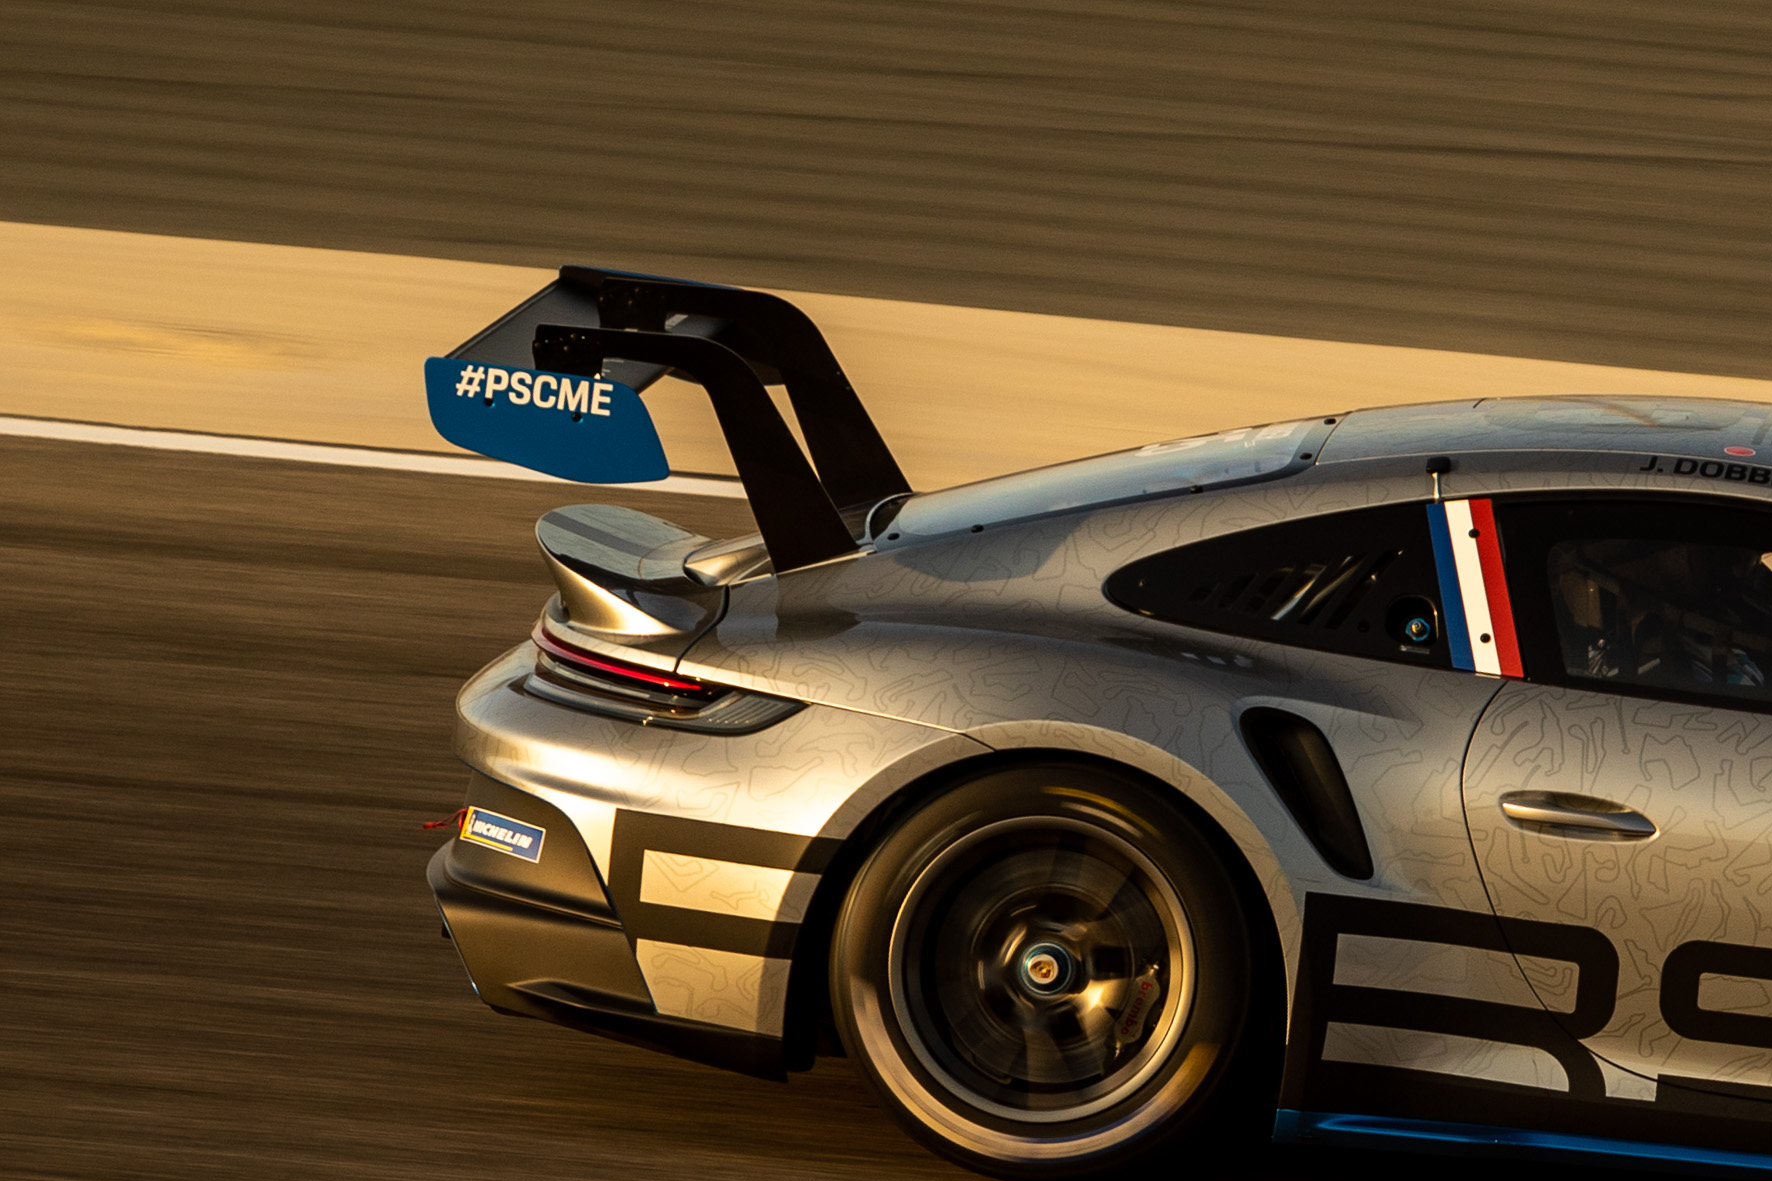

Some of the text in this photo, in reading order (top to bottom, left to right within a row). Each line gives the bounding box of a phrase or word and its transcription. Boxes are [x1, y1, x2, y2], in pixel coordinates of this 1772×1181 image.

[456, 365, 614, 417] #PSCME
[1639, 455, 1665, 473] J.
[472, 819, 533, 849] MICHELIN
[1120, 981, 1153, 1036] brembo
